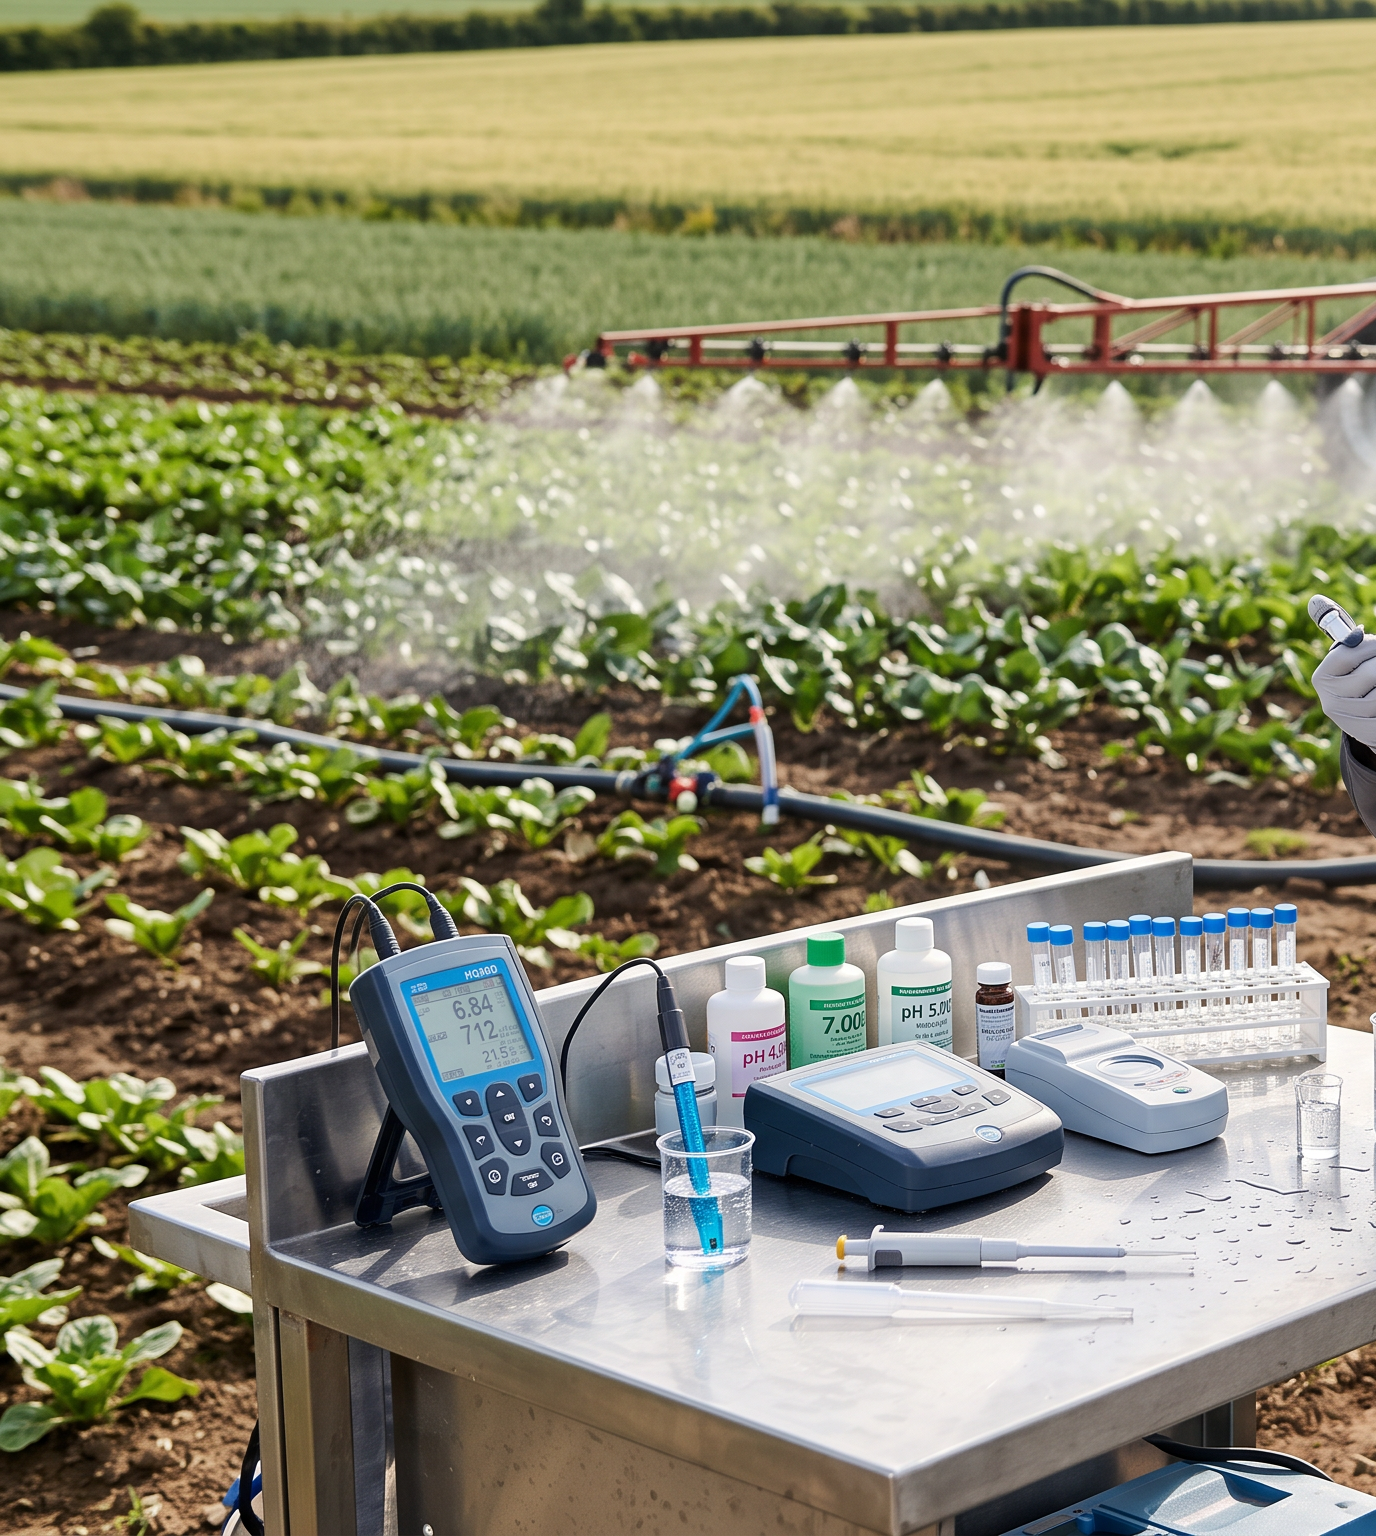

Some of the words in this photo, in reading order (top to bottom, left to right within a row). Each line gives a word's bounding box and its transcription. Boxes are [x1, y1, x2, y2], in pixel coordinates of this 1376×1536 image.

[452, 993, 494, 1020] 6.84
[901, 1004, 923, 1022] pH
[459, 1019, 499, 1046] 712
[482, 1045, 509, 1063] 21.5
[743, 1049, 765, 1069] pH
